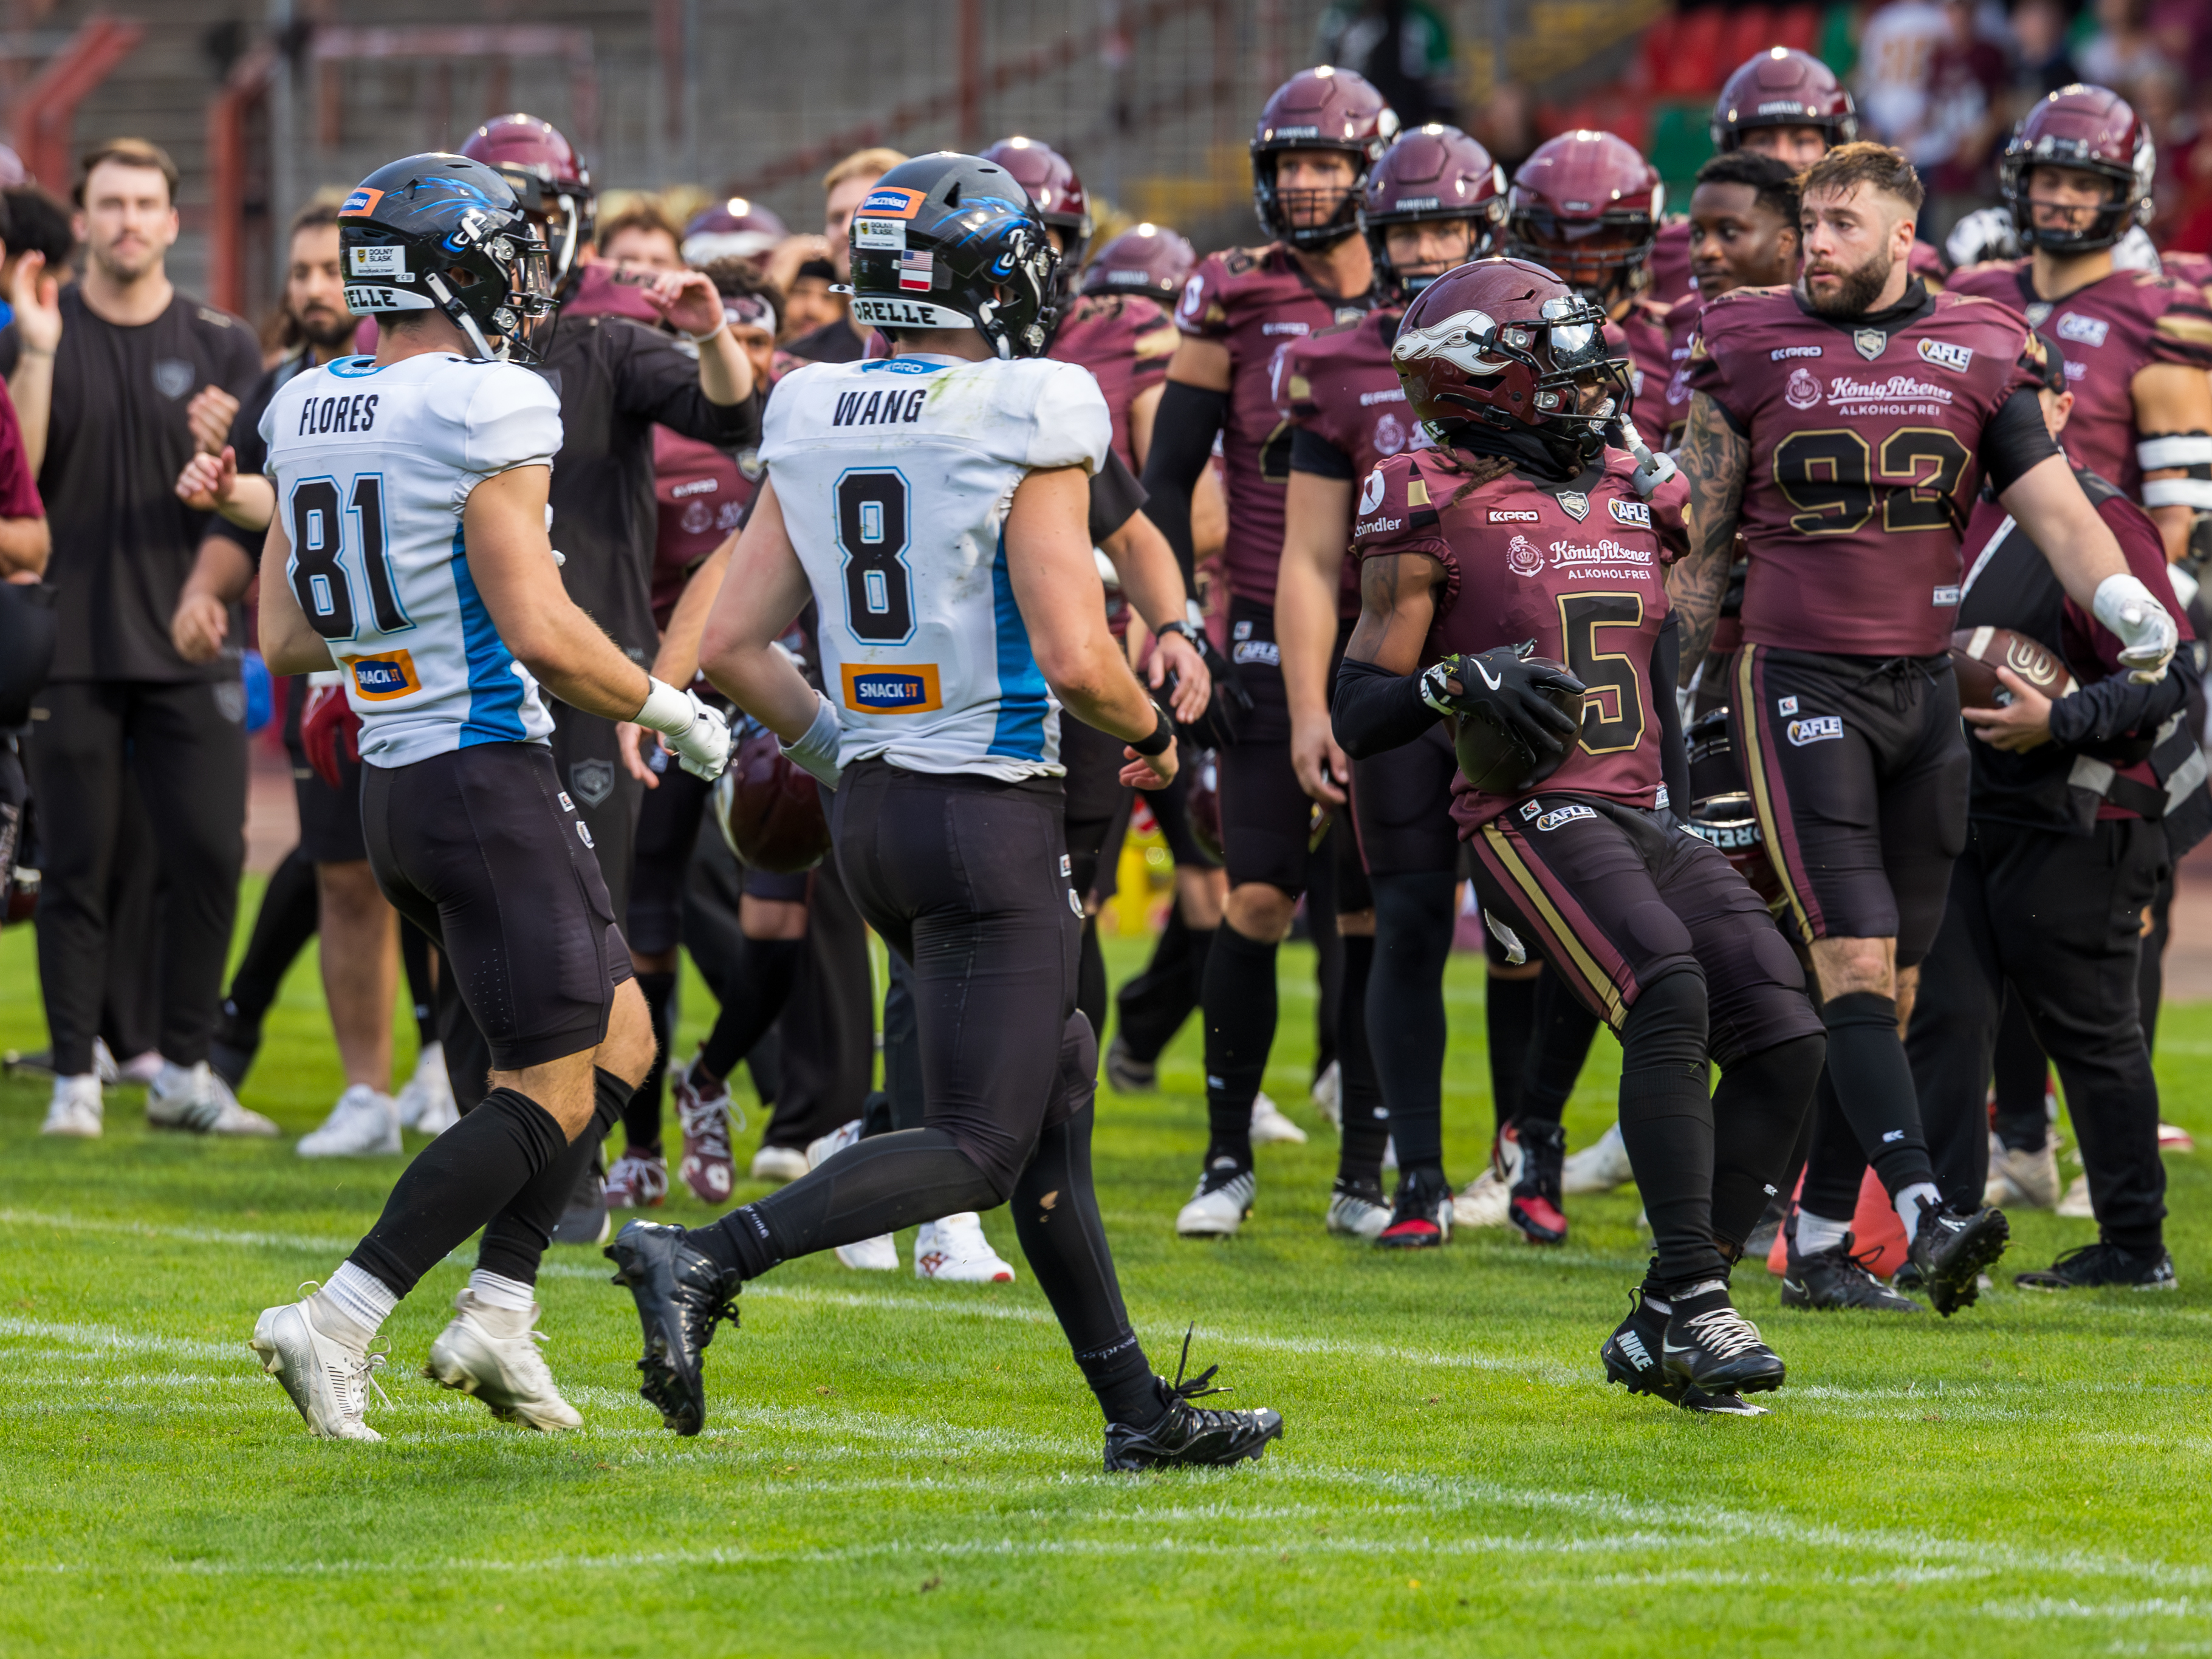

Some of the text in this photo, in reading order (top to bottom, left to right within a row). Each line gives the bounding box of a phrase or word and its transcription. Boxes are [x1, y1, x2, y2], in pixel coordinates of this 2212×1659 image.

[1926, 343, 1968, 365] AFLE
[299, 394, 378, 436] FLORES
[833, 389, 927, 426] WANG
[1839, 403, 1940, 417] ALKOHOLFREI
[1773, 426, 1972, 536] 92
[1355, 516, 1402, 537] hindler
[1618, 502, 1649, 523] AFLE
[286, 472, 417, 643] 81
[833, 466, 917, 646] 8
[1568, 569, 1651, 580] ALKOHOLFREI
[1556, 591, 1645, 756] 5
[1798, 719, 1840, 740] AFLE
[1550, 807, 1592, 826] AFLE
[1617, 1330, 1654, 1372] NIKE
